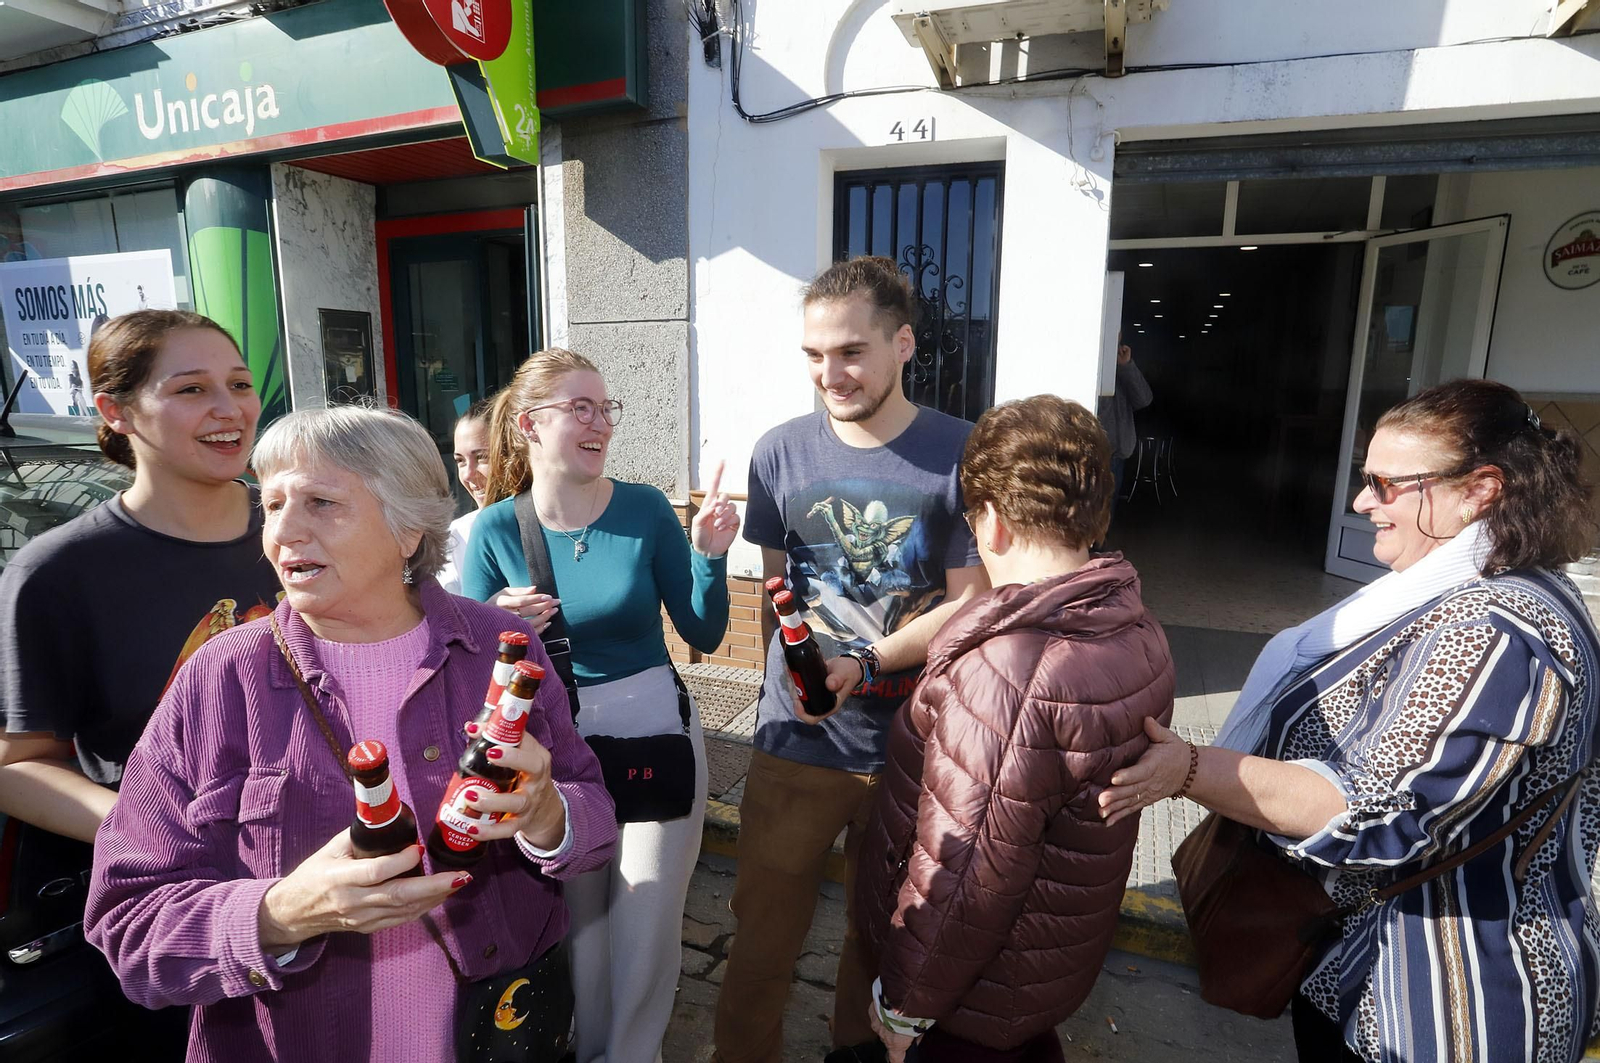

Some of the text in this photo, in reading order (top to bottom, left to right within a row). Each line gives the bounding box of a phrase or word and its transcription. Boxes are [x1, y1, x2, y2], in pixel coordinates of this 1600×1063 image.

[134, 61, 280, 140] Unicaja
[889, 118, 929, 141] 44
[15, 276, 108, 321] SOMOS MÁS
[22, 333, 31, 345] EN
[31, 333, 39, 345] TU
[27, 355, 35, 367] EN
[35, 355, 43, 367] TU
[30, 377, 38, 389] EN
[38, 377, 47, 389] TU
[447, 831, 475, 843] CERVEZA
[448, 837, 470, 847] PILSEN
